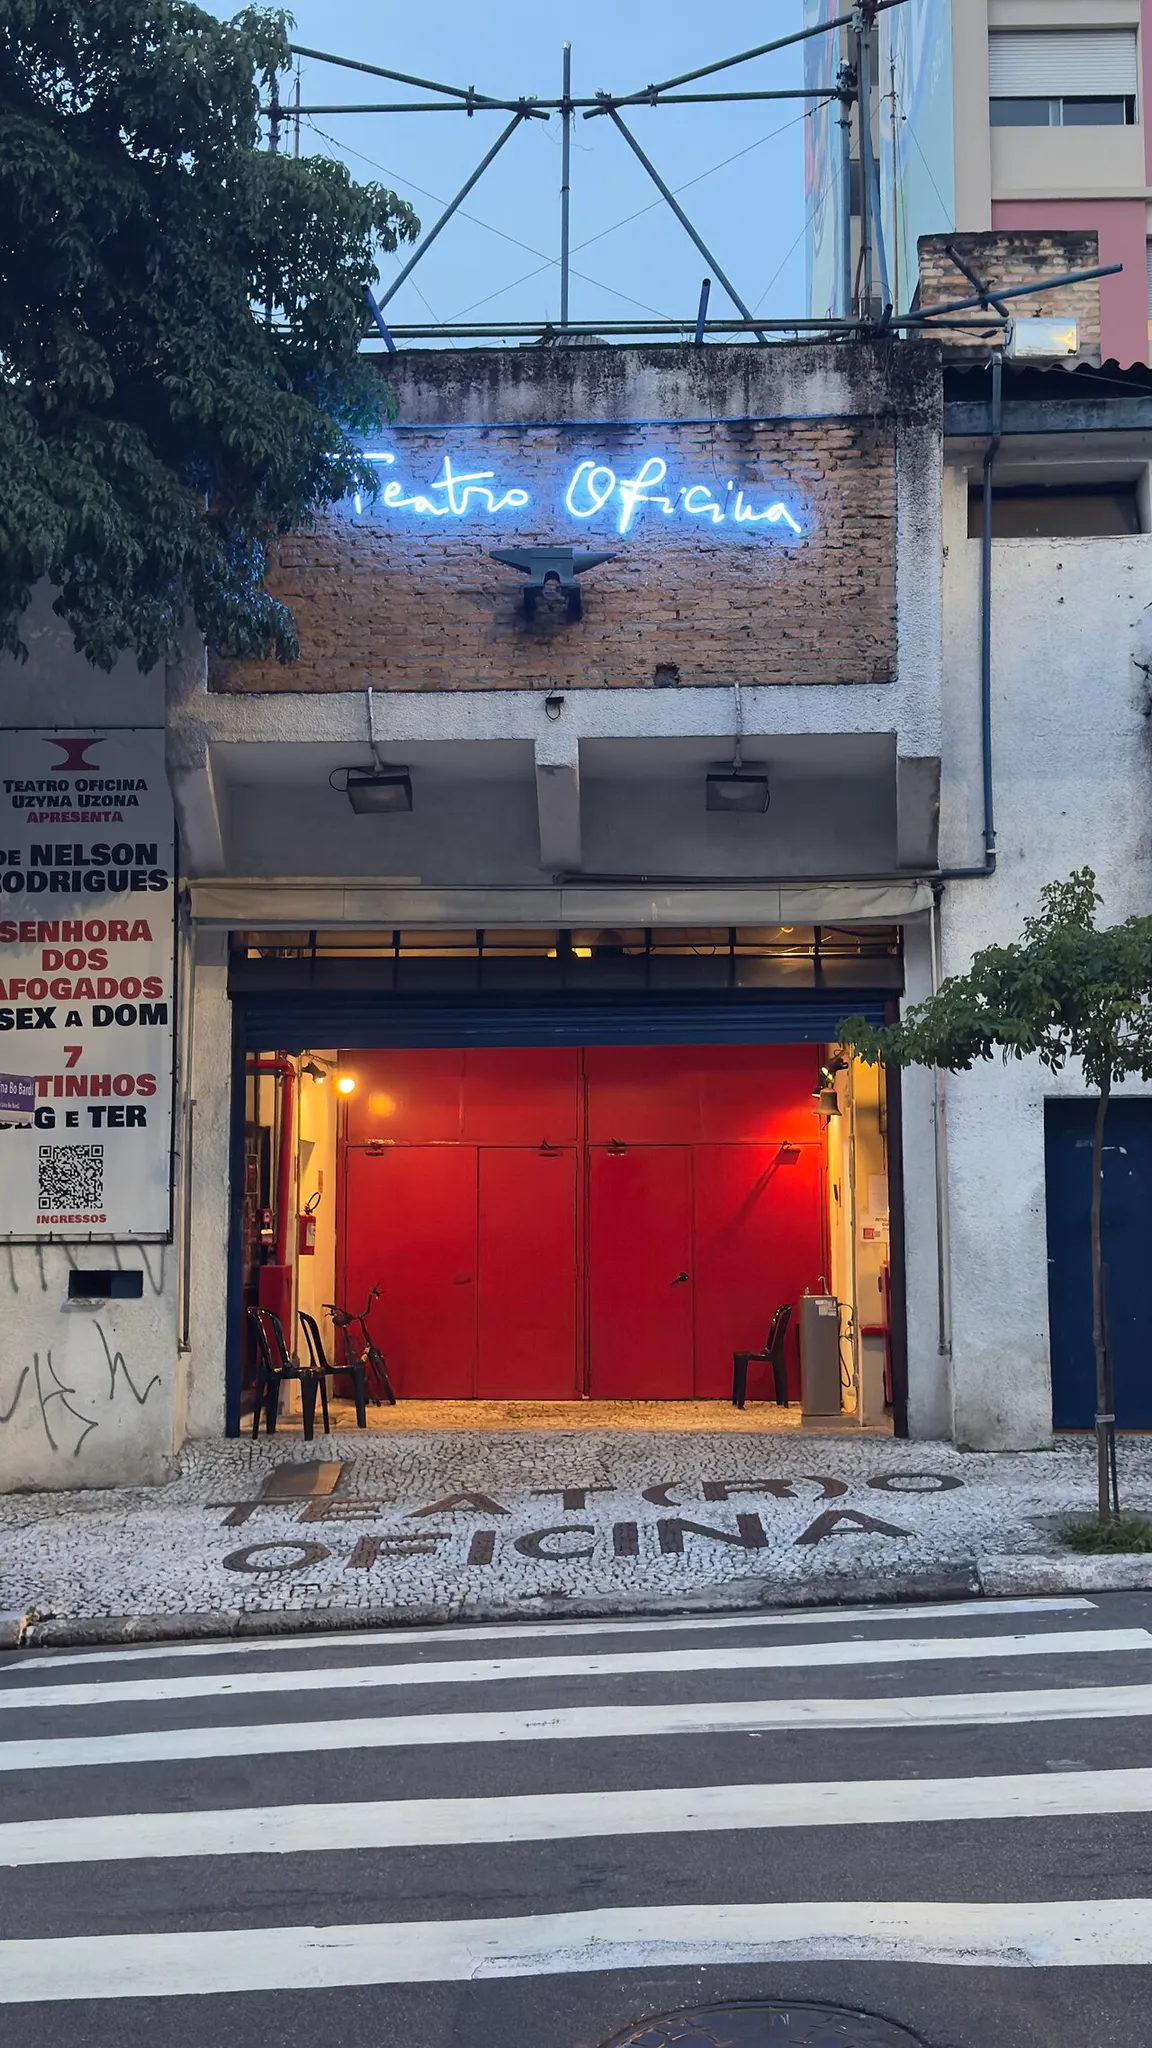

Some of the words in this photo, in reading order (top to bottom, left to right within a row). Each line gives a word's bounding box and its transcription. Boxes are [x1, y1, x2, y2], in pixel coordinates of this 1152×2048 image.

[322, 452, 529, 515] Teatro
[566, 457, 802, 534] Oficina
[3, 779, 69, 793] TEATRO
[75, 778, 148, 792] OFICINA
[12, 795, 72, 809] UZYNA
[78, 794, 140, 808] UZONA
[26, 811, 124, 823] APRESENTA
[30, 843, 158, 867] NELSON
[0, 869, 169, 893] ODRIGUES
[0, 919, 153, 943] SENHORA
[41, 949, 109, 972] DOS
[0, 1006, 57, 1031] SEX
[64, 1011, 83, 1028] A
[92, 1003, 168, 1027] DOM
[63, 1046, 83, 1068] 7
[9, 1081, 17, 1095] Bo
[34, 1073, 157, 1098] TINHOS
[66, 1111, 79, 1128] E
[87, 1105, 147, 1128] TER
[36, 1214, 107, 1225] INGRESSOS
[222, 1508, 916, 1573] OFICINA
